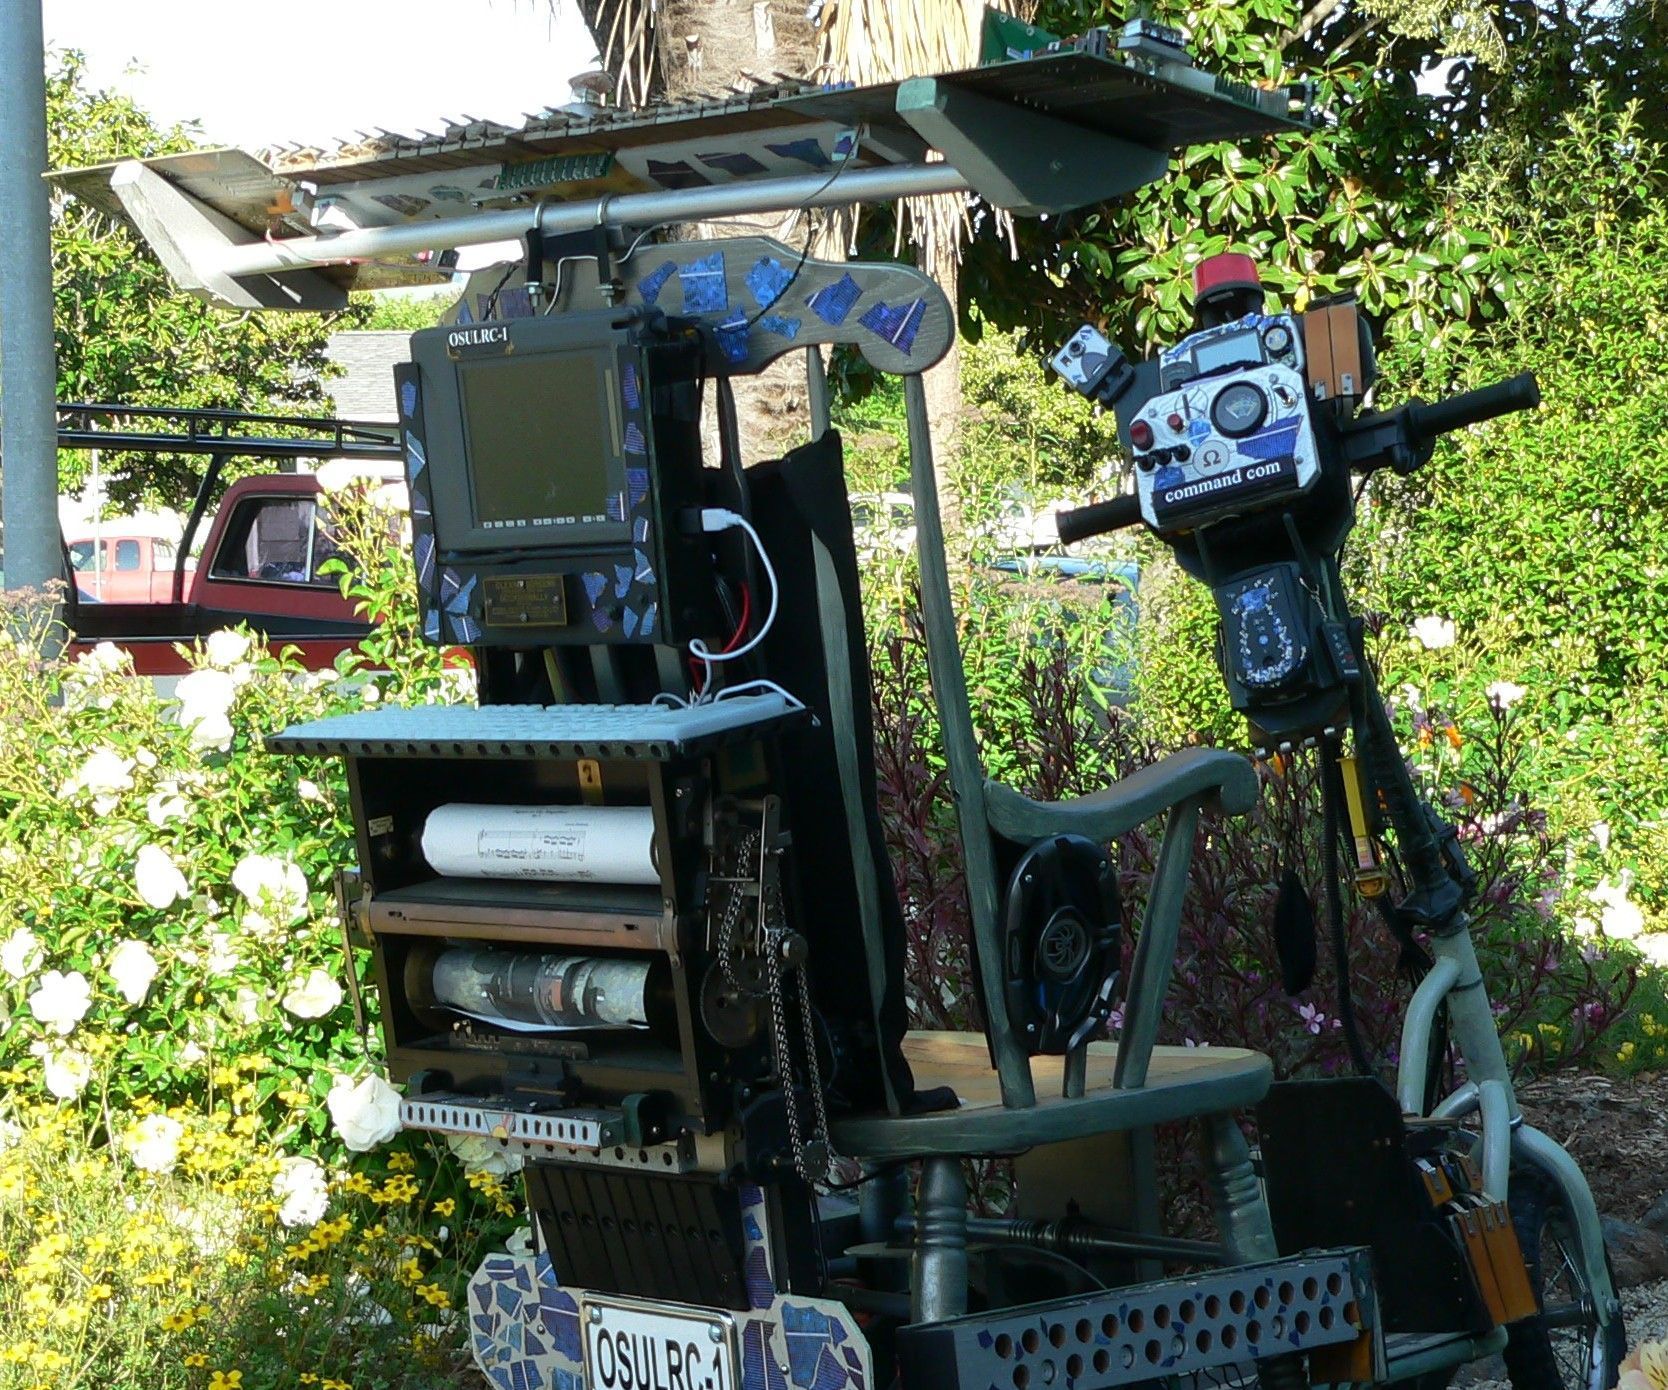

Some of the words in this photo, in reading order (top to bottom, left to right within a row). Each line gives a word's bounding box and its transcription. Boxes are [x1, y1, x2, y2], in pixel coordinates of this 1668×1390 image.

[448, 327, 507, 347] OSULRC-1
[1165, 470, 1242, 502] command
[1246, 462, 1281, 480] com
